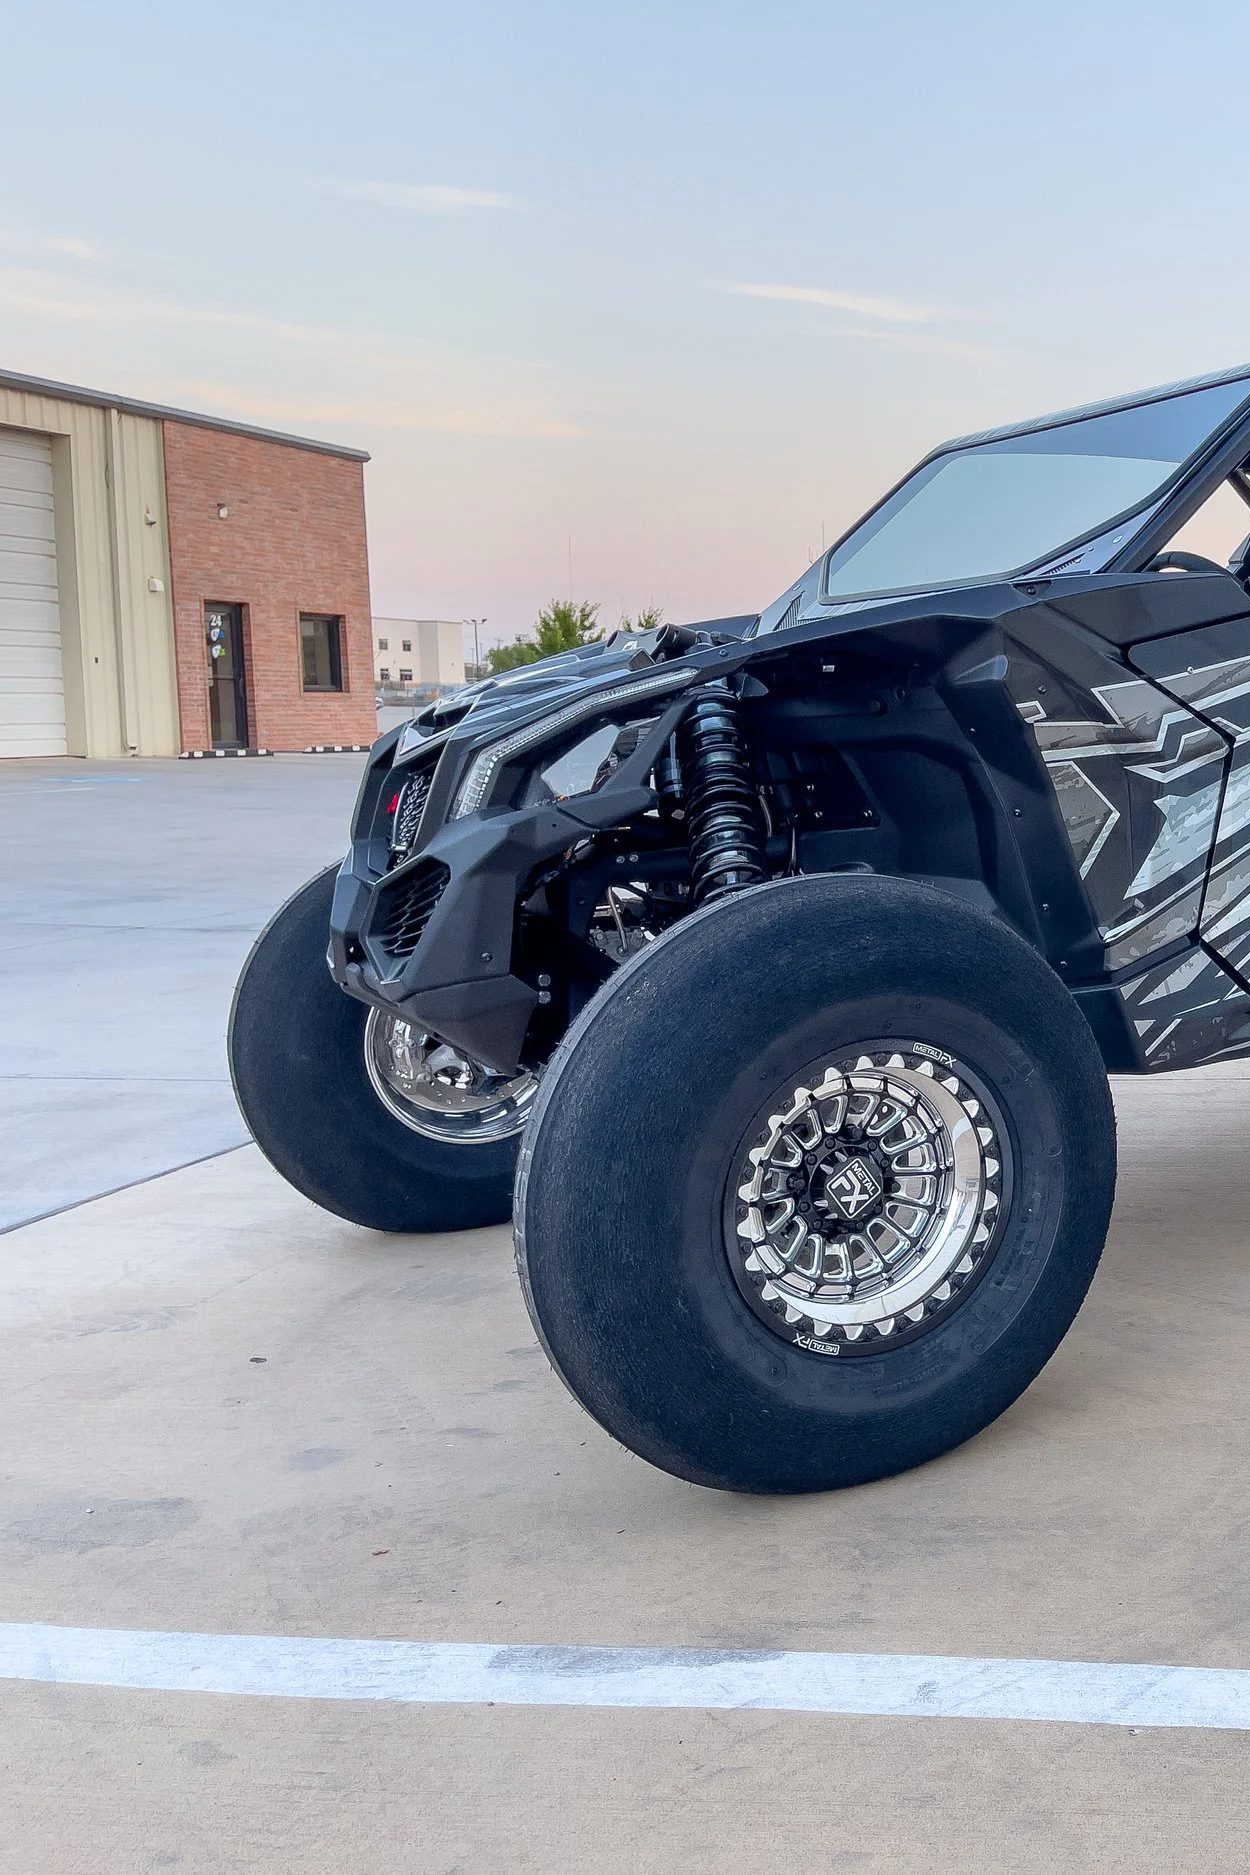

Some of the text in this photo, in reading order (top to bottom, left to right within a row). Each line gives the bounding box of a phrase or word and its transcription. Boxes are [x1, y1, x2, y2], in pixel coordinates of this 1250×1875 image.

[210, 613, 222, 627] 24
[915, 1044, 957, 1069] METAL FX
[831, 1169, 870, 1214] FX
[851, 1162, 876, 1196] METAL
[792, 1332, 838, 1353] METAL FX
